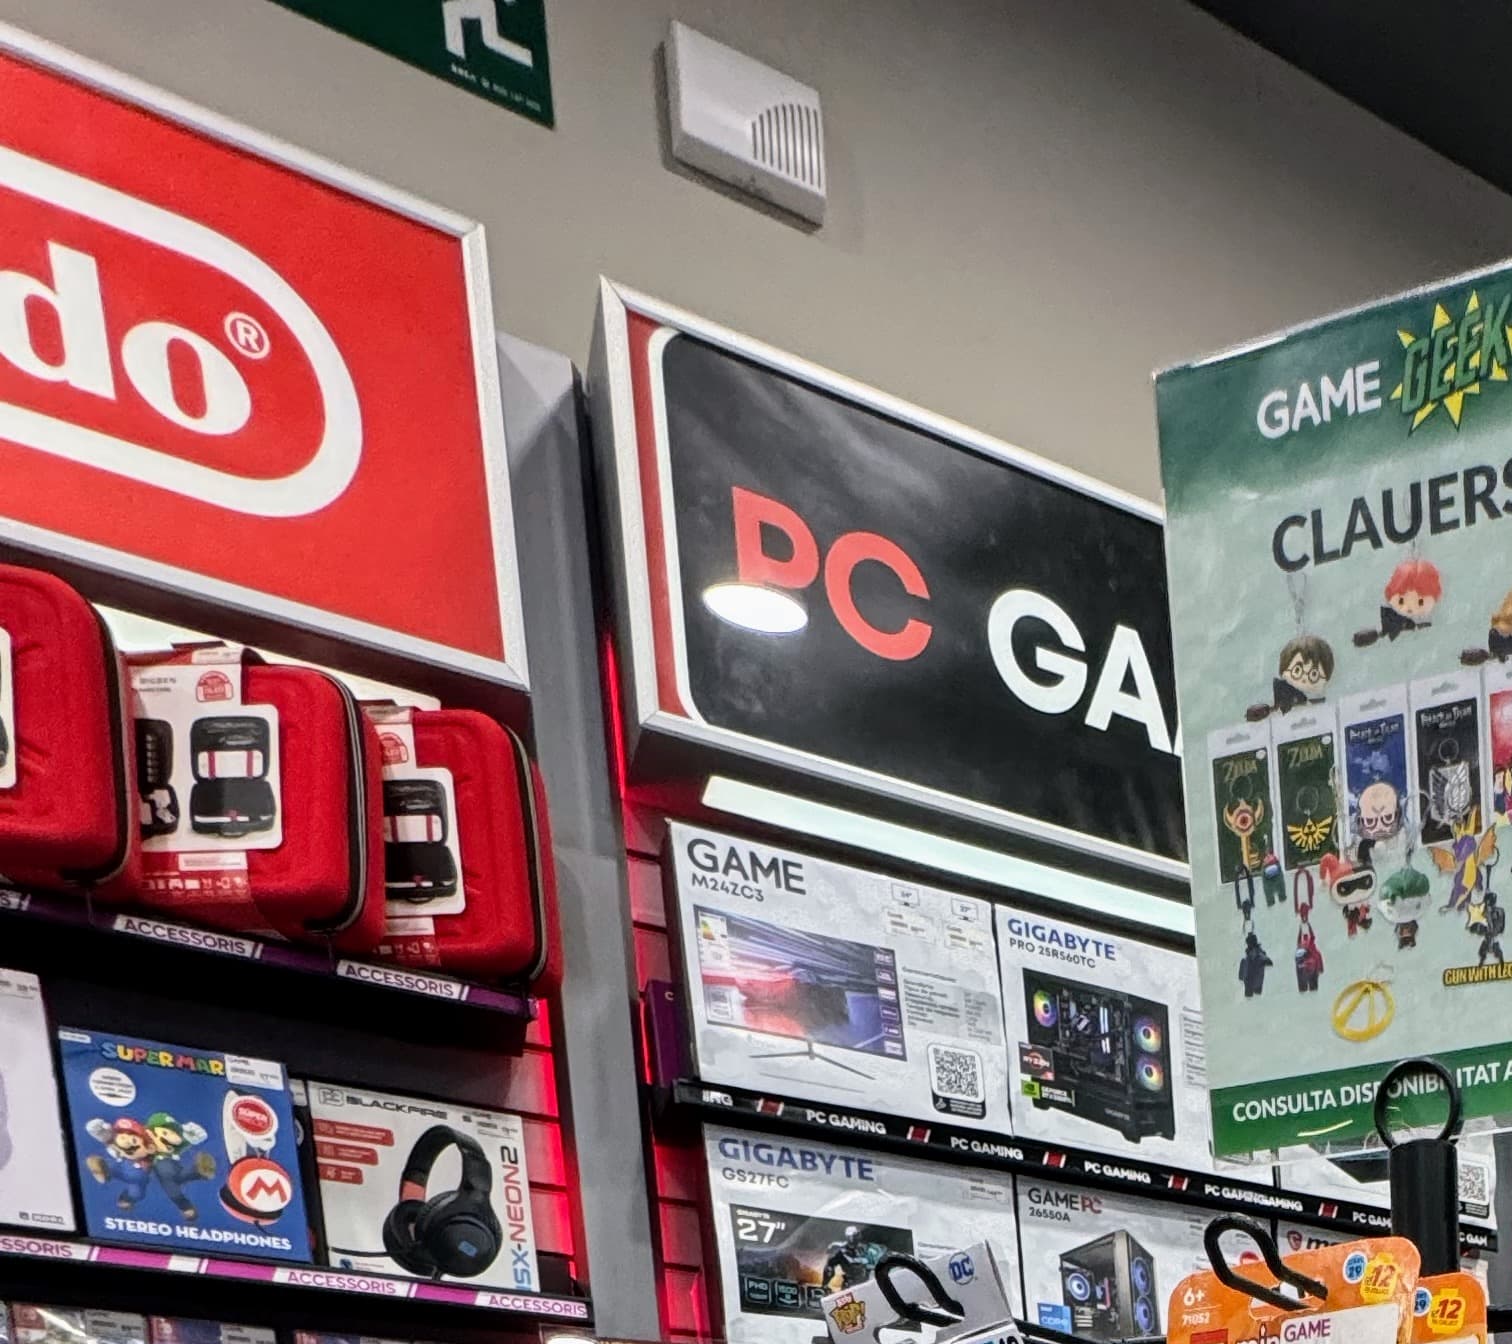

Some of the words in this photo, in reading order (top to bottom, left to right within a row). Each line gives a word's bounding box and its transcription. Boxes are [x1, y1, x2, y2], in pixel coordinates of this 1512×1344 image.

[1257, 360, 1382, 439] GAME
[731, 486, 932, 661] PC
[688, 839, 807, 896] GAME
[692, 873, 764, 903] M24ZC3
[123, 917, 248, 956] ACCESSORIS
[1008, 918, 1117, 962] GIGABYTE
[1010, 938, 1036, 954] PRO
[344, 962, 456, 998] ACCESSORIS
[102, 1042, 174, 1069] SUPER
[175, 1052, 226, 1077] MAR
[346, 1094, 448, 1121] BLACKFIRE
[1232, 1089, 1337, 1123] CONSULTA
[806, 1109, 827, 1124] PC
[829, 1113, 887, 1134] GAMING
[719, 1137, 875, 1182] GIGABYTE
[951, 1136, 969, 1150] PC
[971, 1140, 1024, 1160] GAMING
[722, 1165, 790, 1189] GS27FC
[1084, 1160, 1102, 1174] PC
[1104, 1163, 1151, 1184] GAMING
[105, 1216, 172, 1238] STEREO
[176, 1225, 292, 1251] HEADPHONES
[951, 1254, 975, 1281] DC
[1371, 1266, 1396, 1288] 12
[288, 1270, 397, 1296] ACCESSORIS
[1183, 1286, 1206, 1307] 6+
[489, 1295, 587, 1317] ACCESSORIS
[1182, 1311, 1211, 1326] 71052
[1438, 1298, 1463, 1320] 12
[1284, 1318, 1331, 1342] GAME
